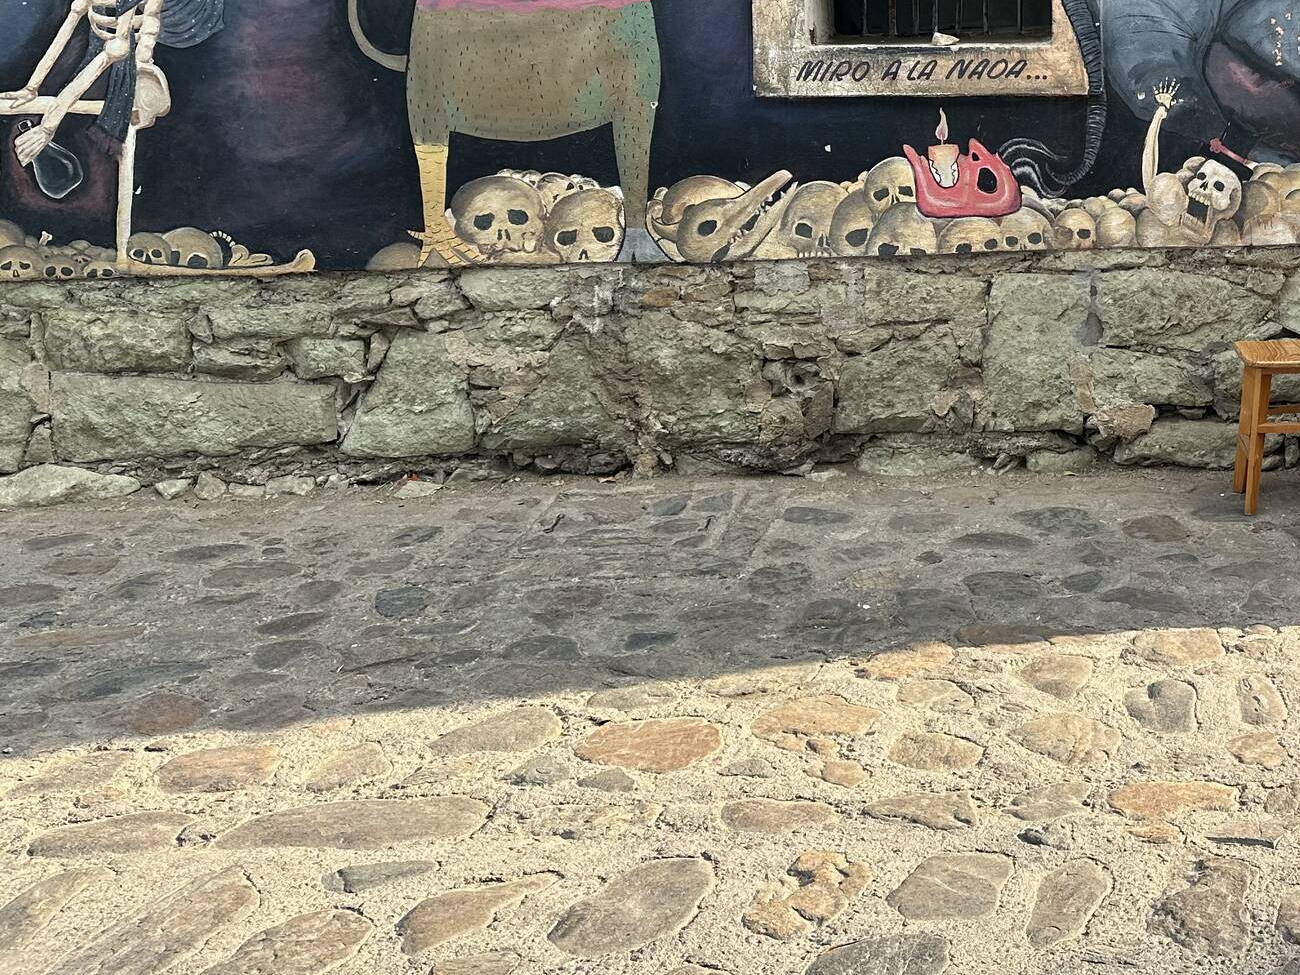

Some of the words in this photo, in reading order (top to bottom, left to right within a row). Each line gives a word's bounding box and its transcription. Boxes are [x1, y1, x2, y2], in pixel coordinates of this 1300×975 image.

[795, 59, 871, 82] MIRO
[881, 59, 902, 81] A
[906, 59, 938, 81] LA
